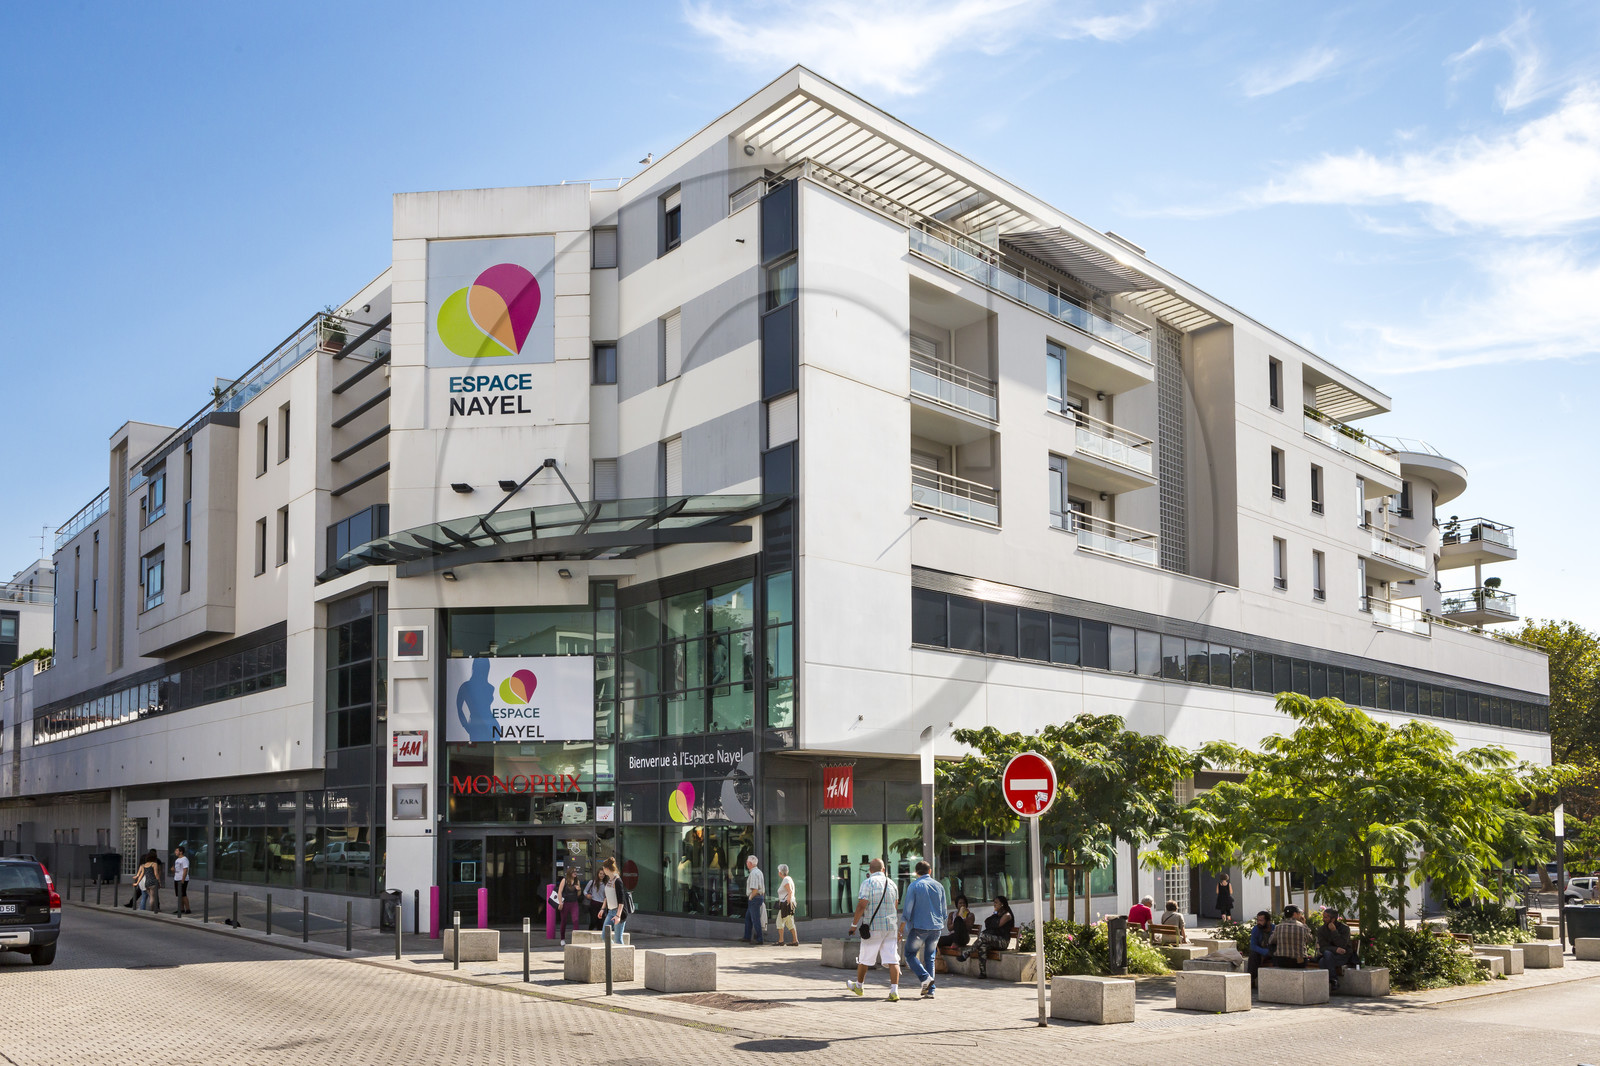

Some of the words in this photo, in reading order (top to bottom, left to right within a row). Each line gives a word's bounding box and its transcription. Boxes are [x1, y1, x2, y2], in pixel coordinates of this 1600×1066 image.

[449, 373, 532, 393] ESPACE
[449, 395, 531, 416] NAYEL
[492, 708, 540, 718] ESPACE
[492, 725, 544, 738] NAYEL
[399, 741, 421, 756] H&M
[629, 756, 670, 769] Bienvenue
[672, 752, 678, 766] à
[680, 751, 714, 768] l'Espace
[717, 747, 743, 766] Nayel
[452, 774, 582, 794] MONOPRIX
[827, 776, 849, 798] H&M
